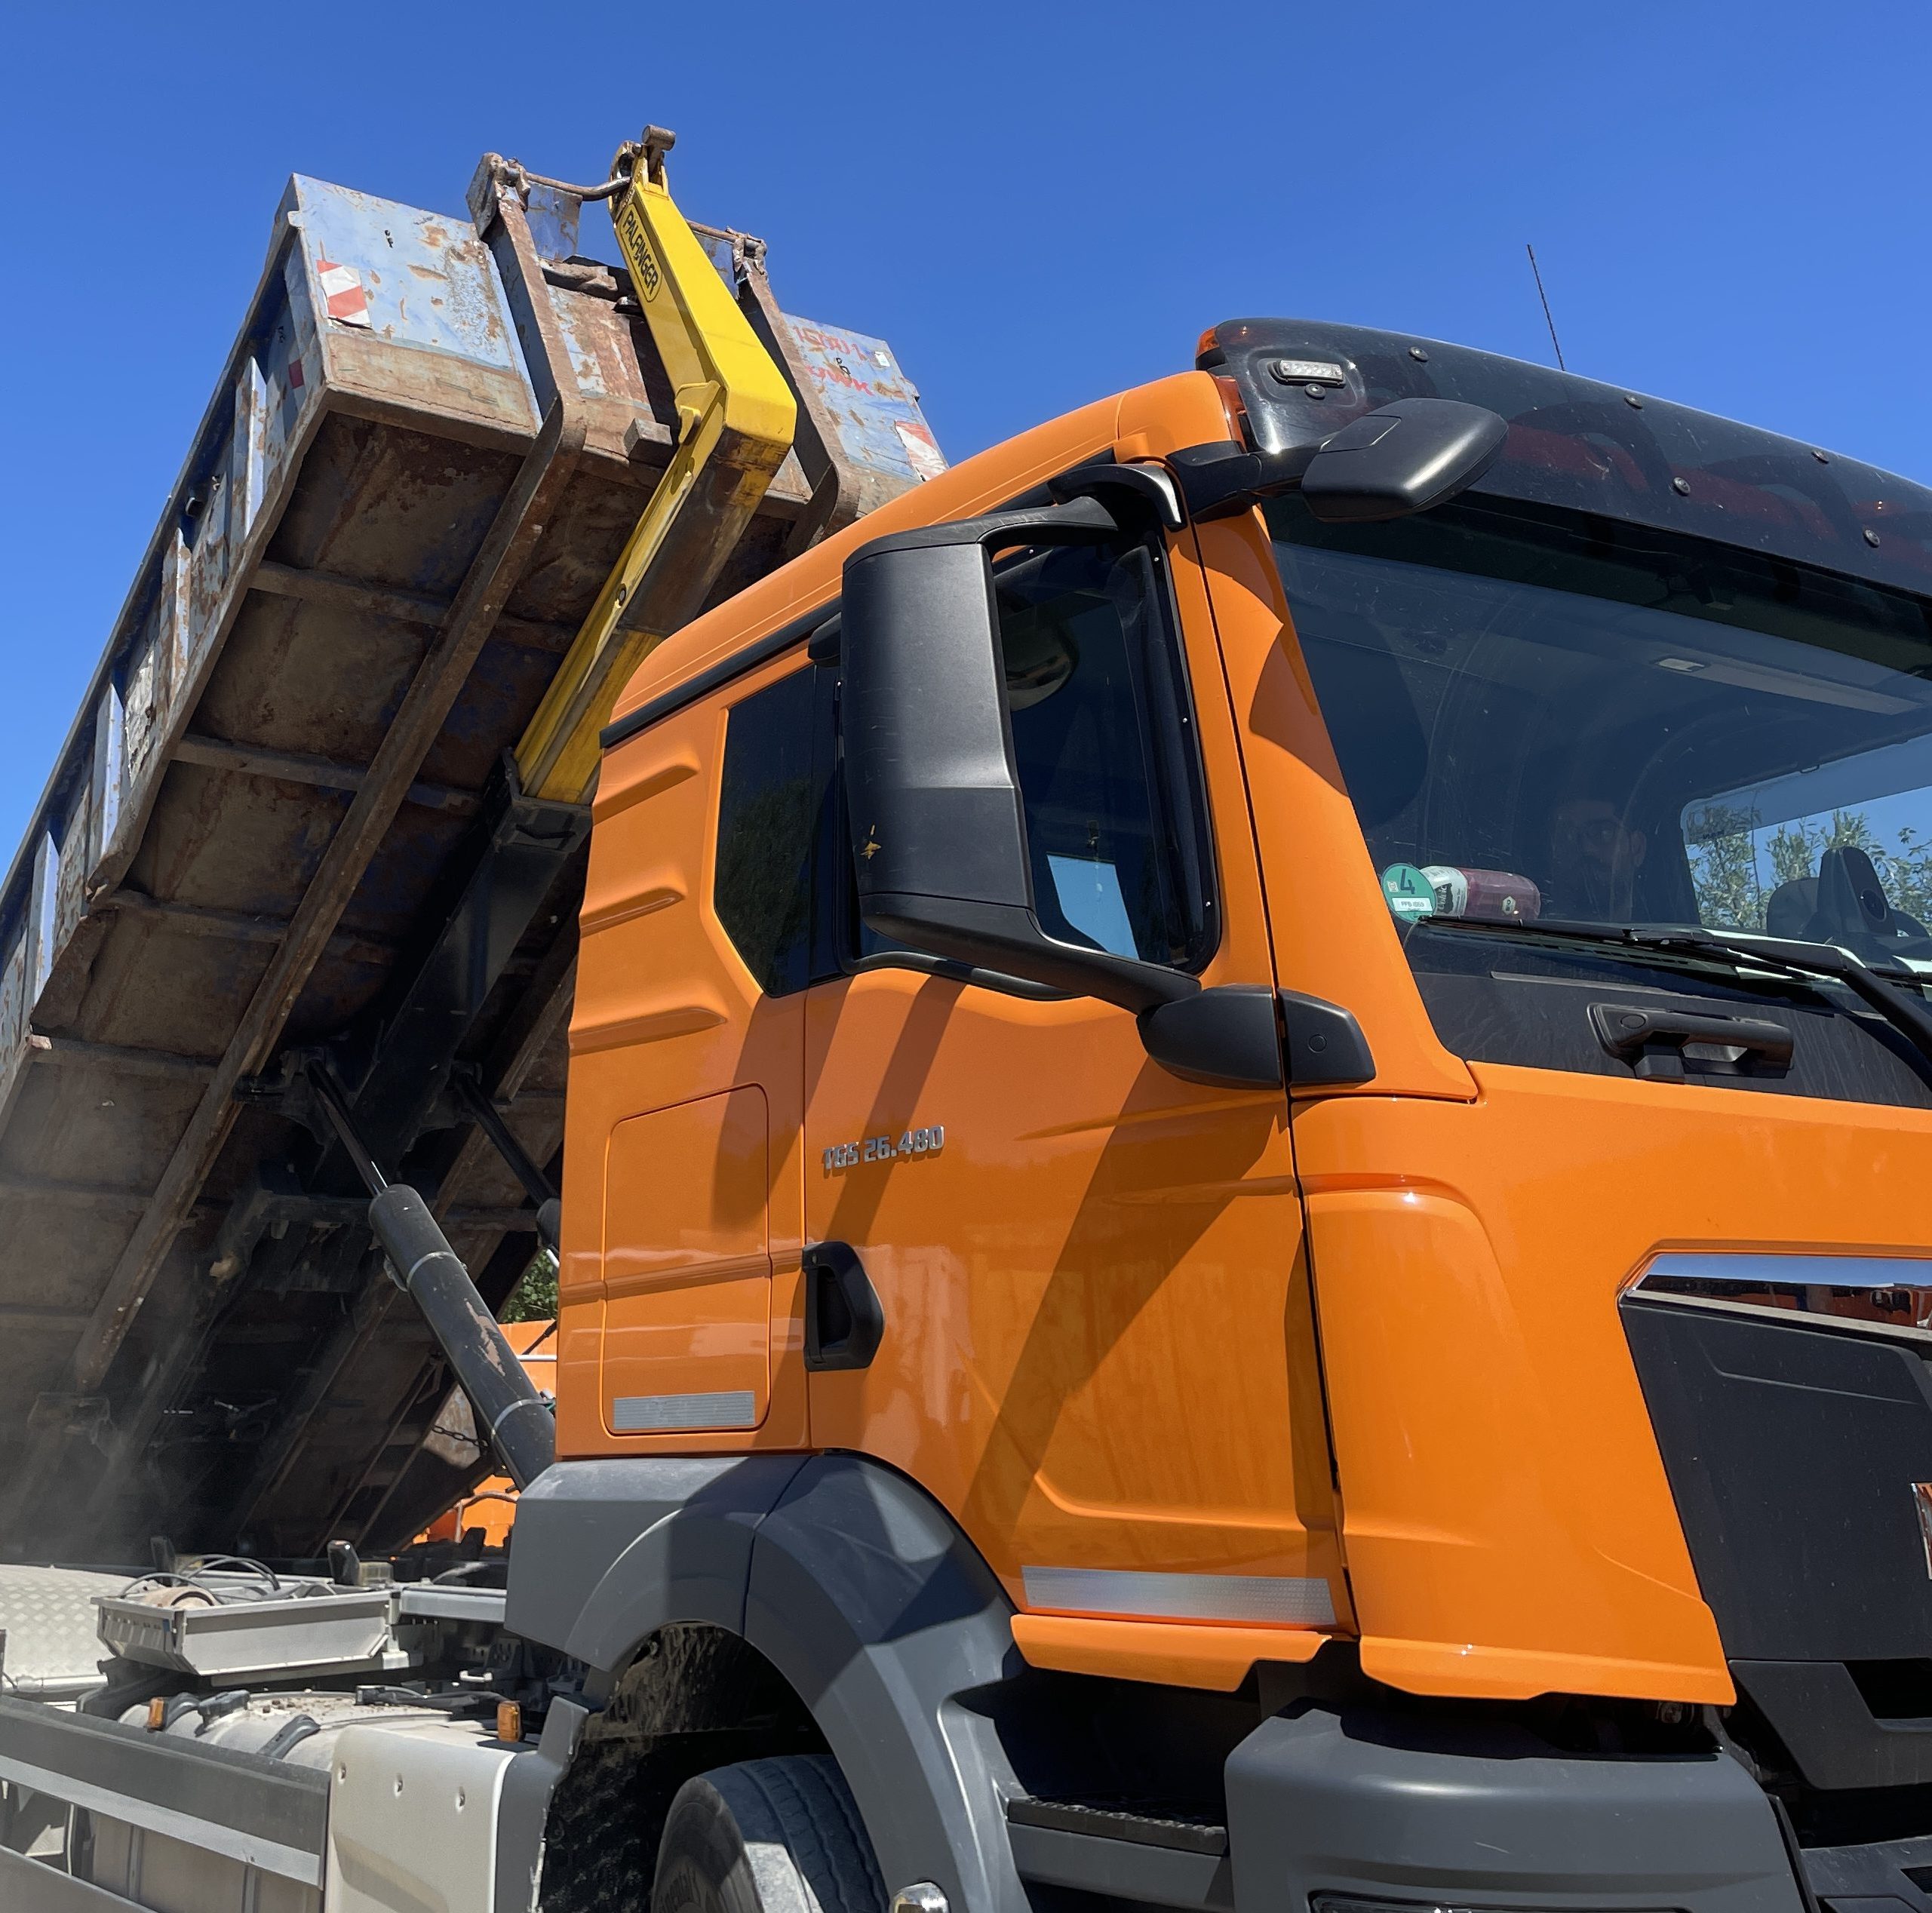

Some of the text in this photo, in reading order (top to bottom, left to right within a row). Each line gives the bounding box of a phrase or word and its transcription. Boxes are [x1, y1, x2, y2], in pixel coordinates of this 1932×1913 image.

[622, 210, 659, 295] PALFINGER
[1400, 868, 1415, 895] 4
[823, 1125, 944, 1170] TGS 26.480
